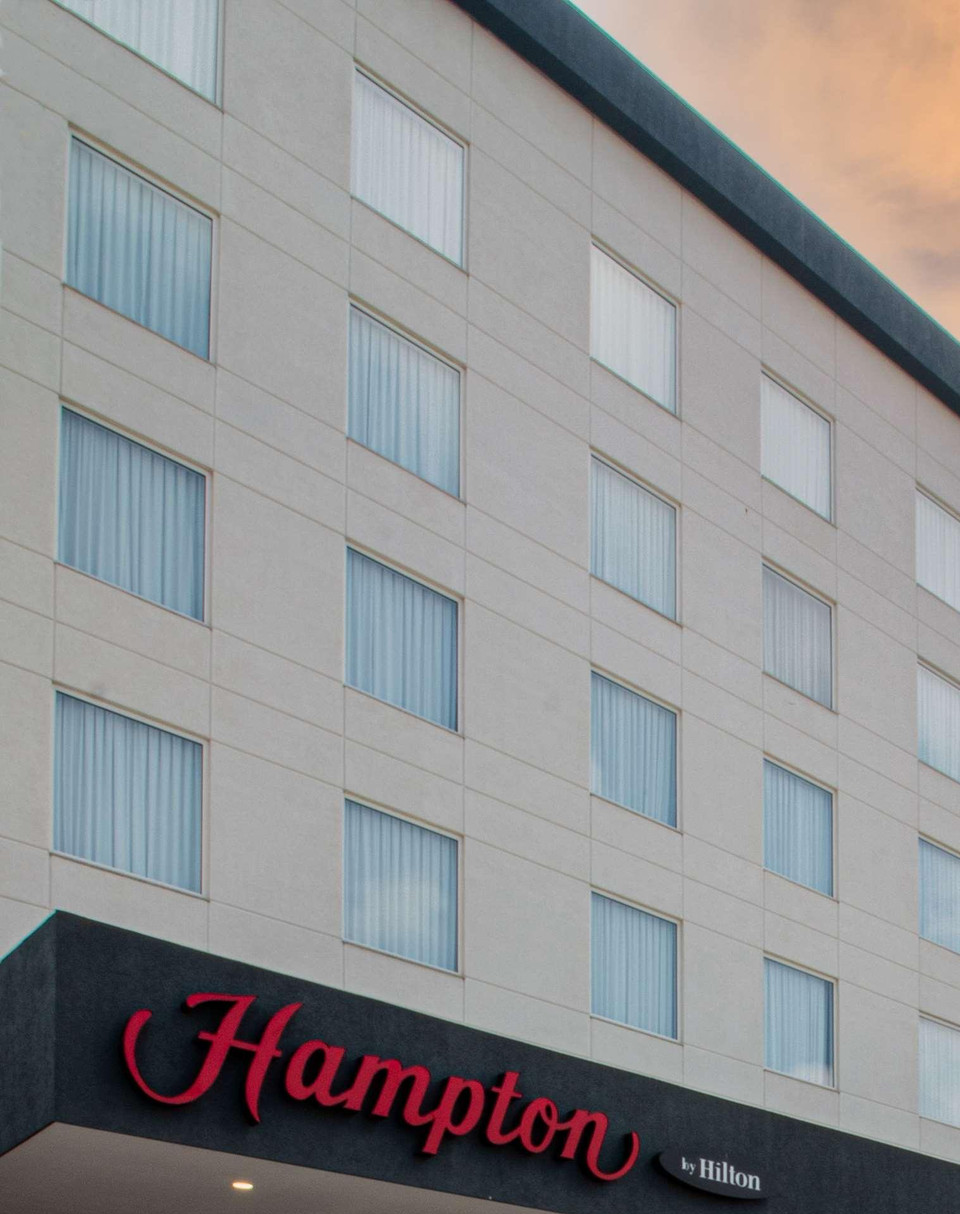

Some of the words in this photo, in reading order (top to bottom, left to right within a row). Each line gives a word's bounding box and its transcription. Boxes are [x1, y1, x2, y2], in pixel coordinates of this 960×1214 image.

[123, 993, 641, 1181] Hampton
[681, 1157, 697, 1175] by
[699, 1158, 761, 1191] Hilton
